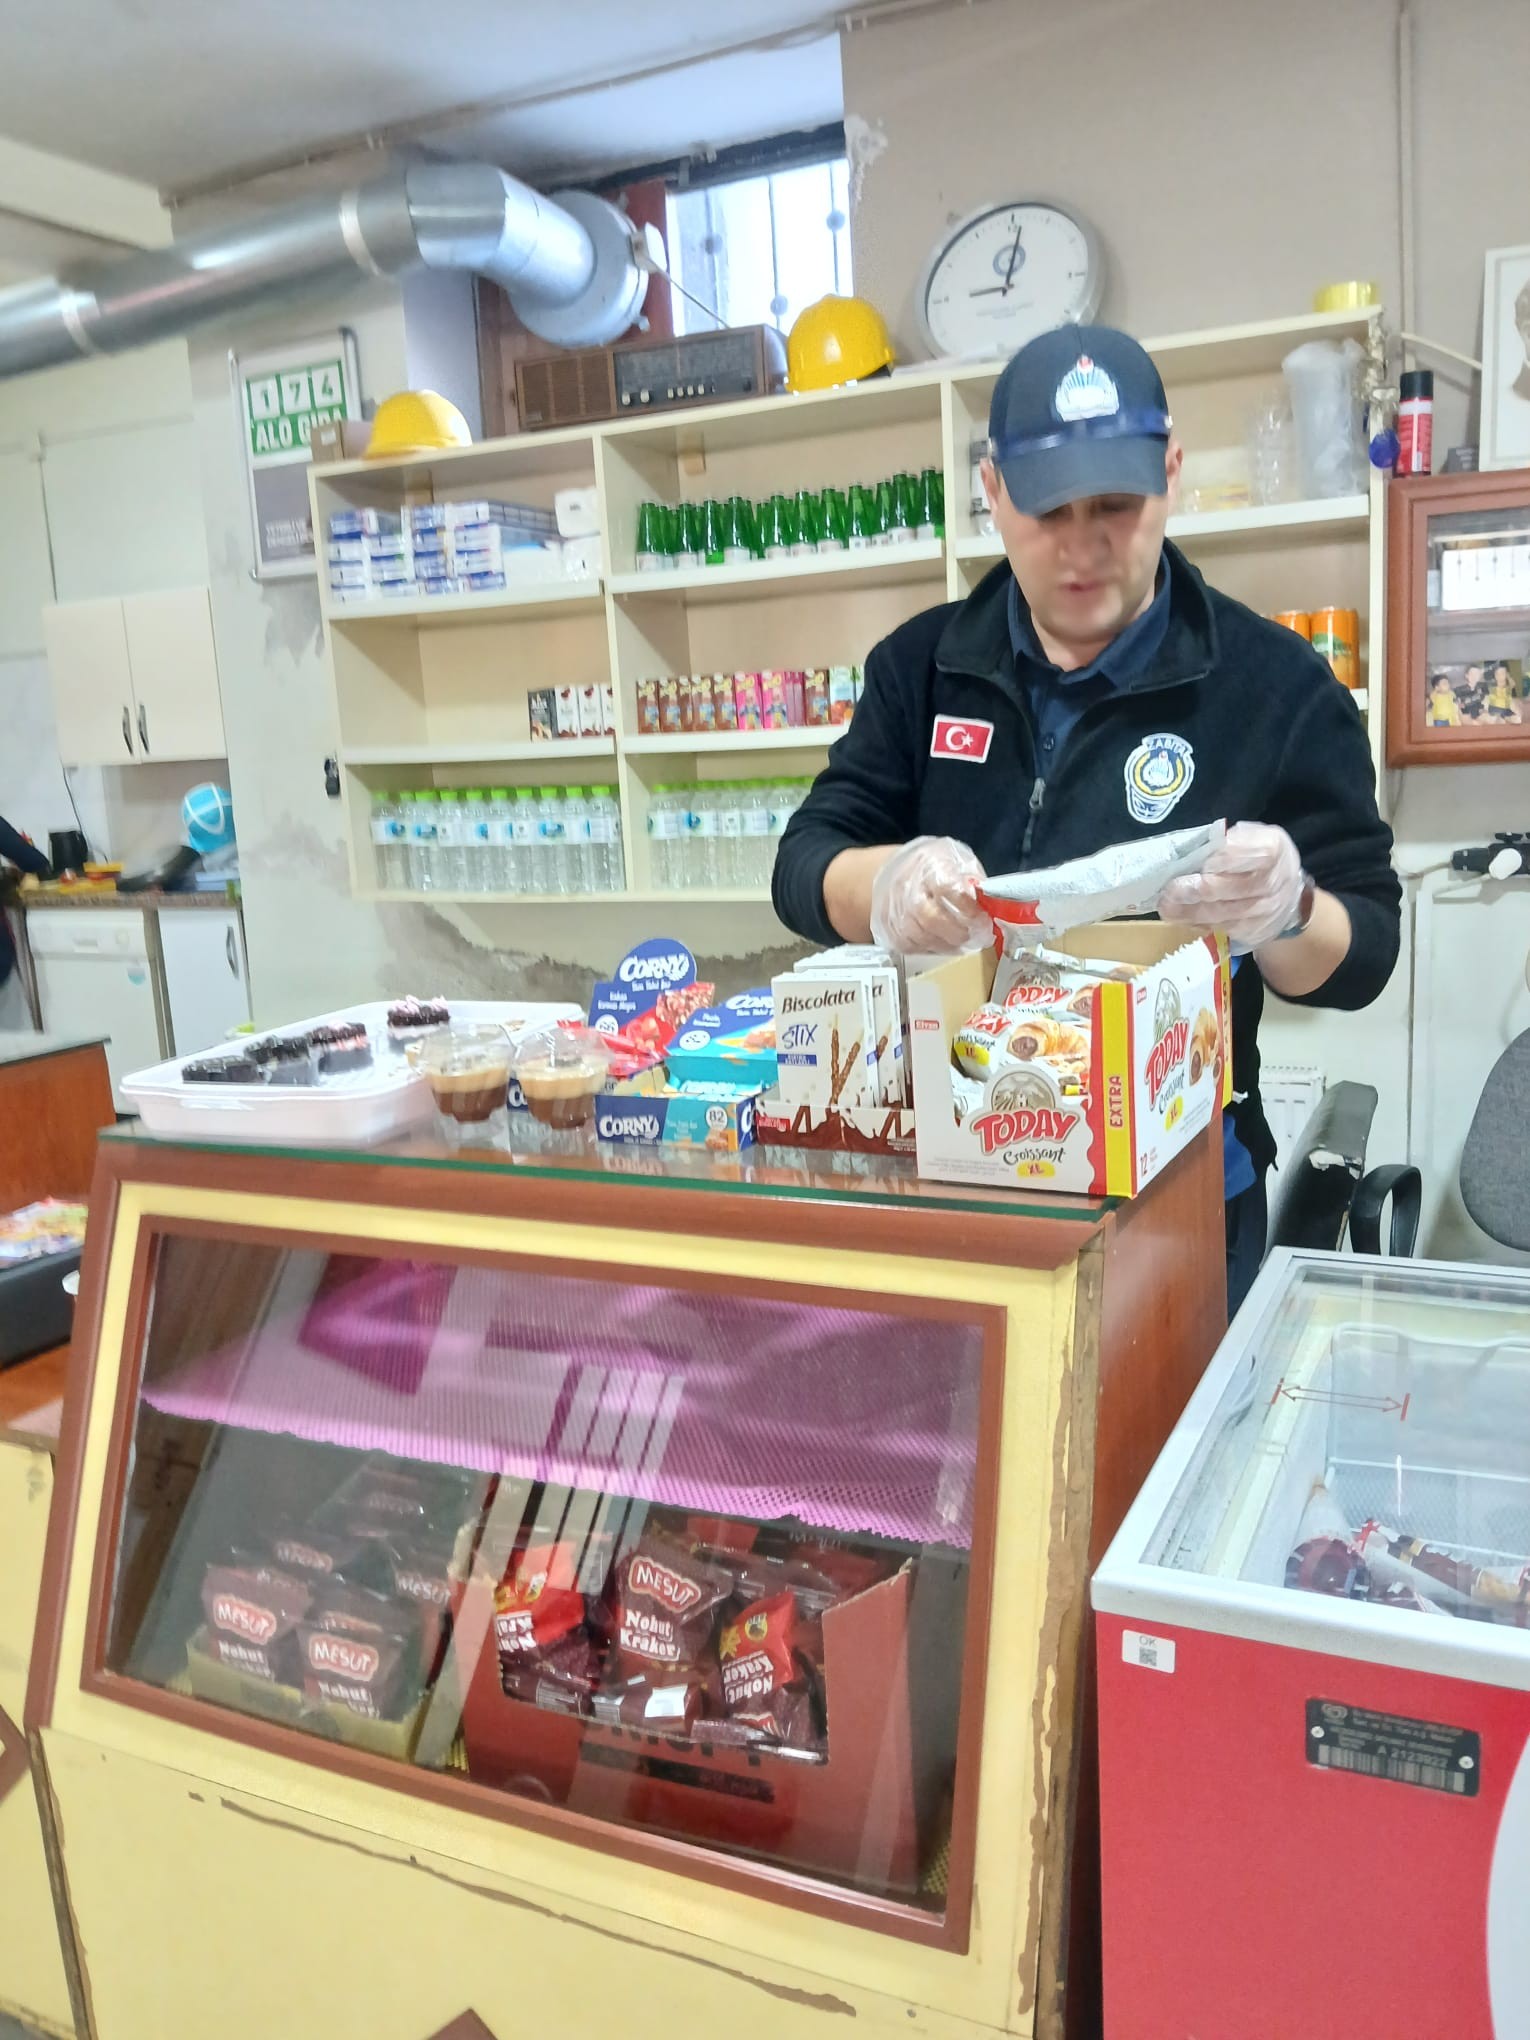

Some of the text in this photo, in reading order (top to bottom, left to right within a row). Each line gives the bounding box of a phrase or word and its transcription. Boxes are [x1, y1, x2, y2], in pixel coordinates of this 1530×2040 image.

[256, 416, 293, 454] ALO
[619, 952, 690, 982] CORNY
[781, 989, 856, 1014] Biscolata
[781, 1023, 818, 1050] STIX
[915, 1020, 939, 1030] Elvan
[1145, 1018, 1190, 1111] TODAY
[1108, 1076, 1123, 1128] EXTRA
[599, 1115, 660, 1139] CORNY
[972, 1108, 1079, 1154] TODAY
[1003, 1147, 1066, 1166] Croissant
[636, 1564, 695, 1606] MESUT
[217, 1603, 270, 1639] MESUT
[625, 1609, 671, 1637] Nohut
[218, 1639, 266, 1663] Nohut
[314, 1640, 371, 1672] MESUT
[620, 1628, 677, 1657] Kraker
[724, 1655, 774, 1684] Kraker
[318, 1681, 371, 1702] Nohut
[727, 1675, 773, 1704] Nohut
